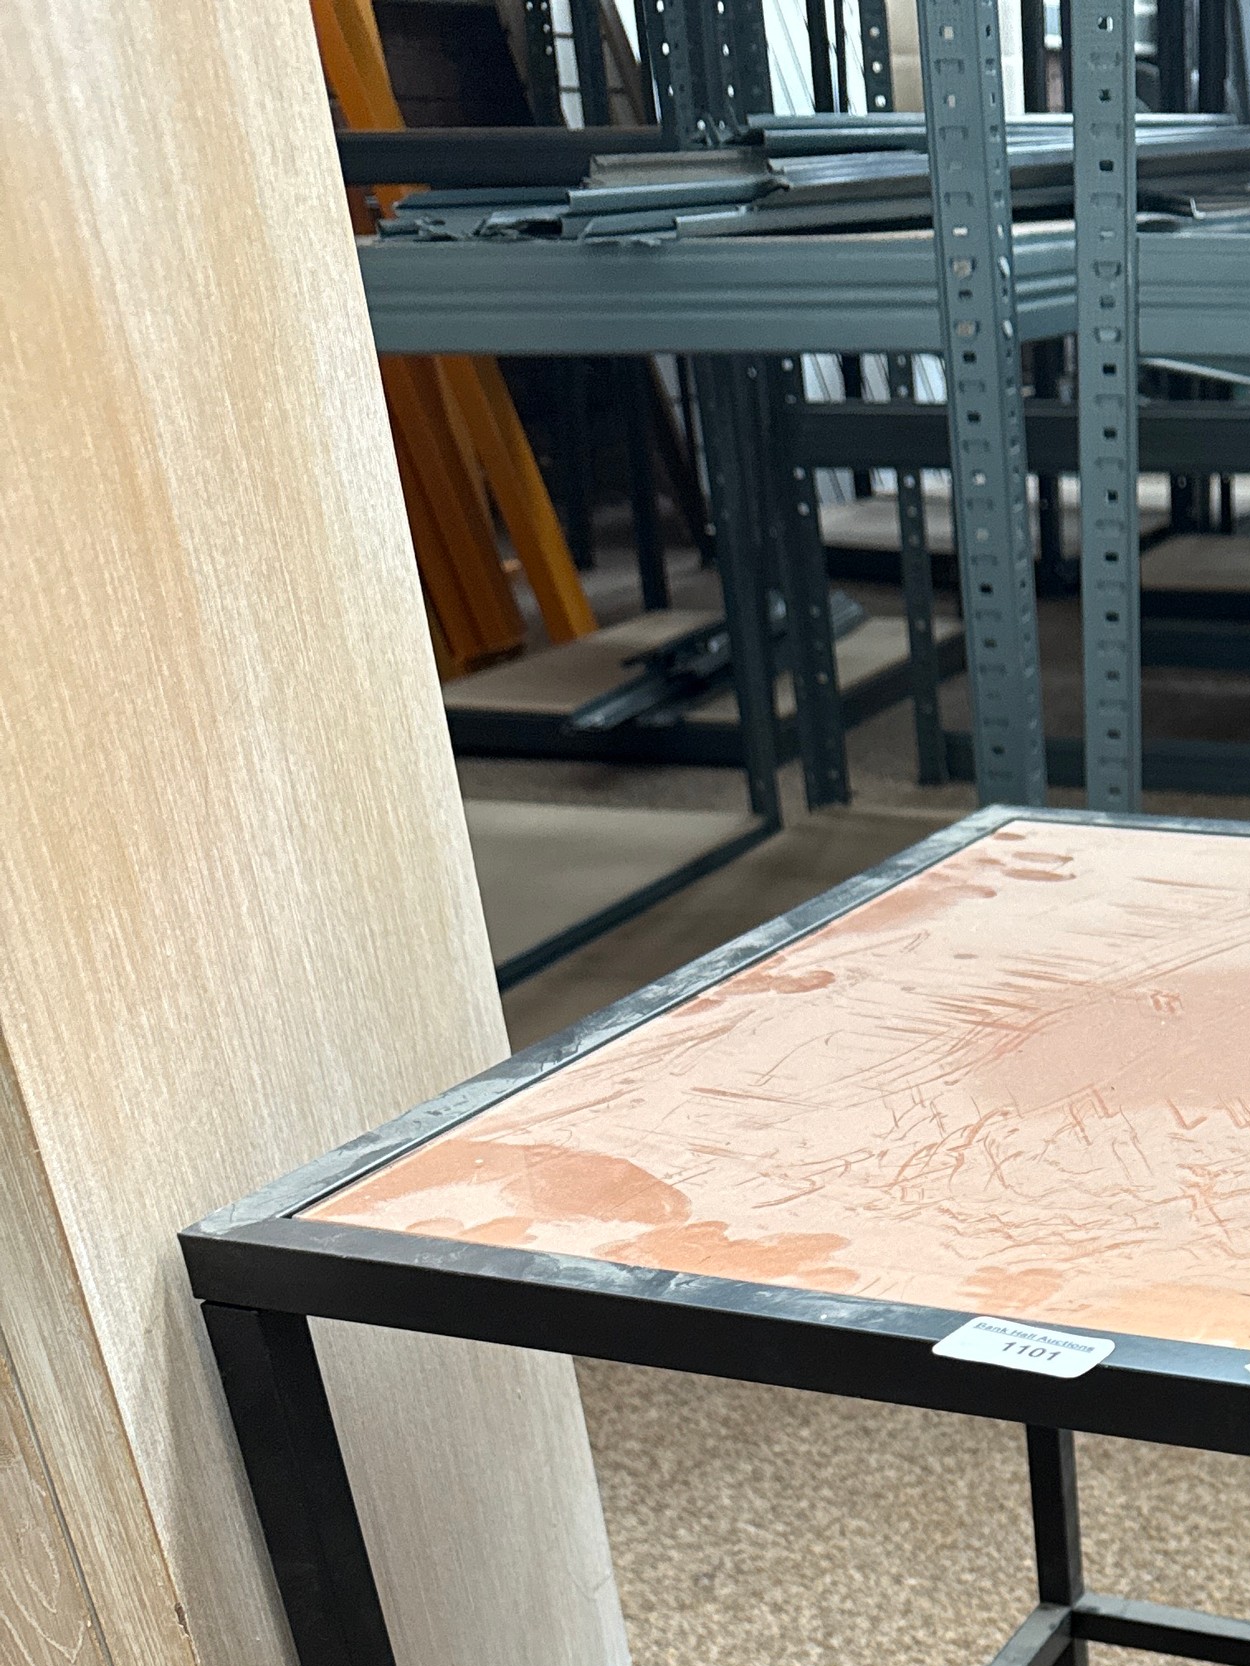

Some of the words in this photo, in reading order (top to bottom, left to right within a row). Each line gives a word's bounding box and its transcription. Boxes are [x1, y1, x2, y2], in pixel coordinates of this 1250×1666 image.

[975, 1322, 1010, 1335] Bank
[1010, 1329, 1036, 1341] Hall
[1037, 1335, 1095, 1352] Auctions
[1002, 1341, 1061, 1361] 1101
